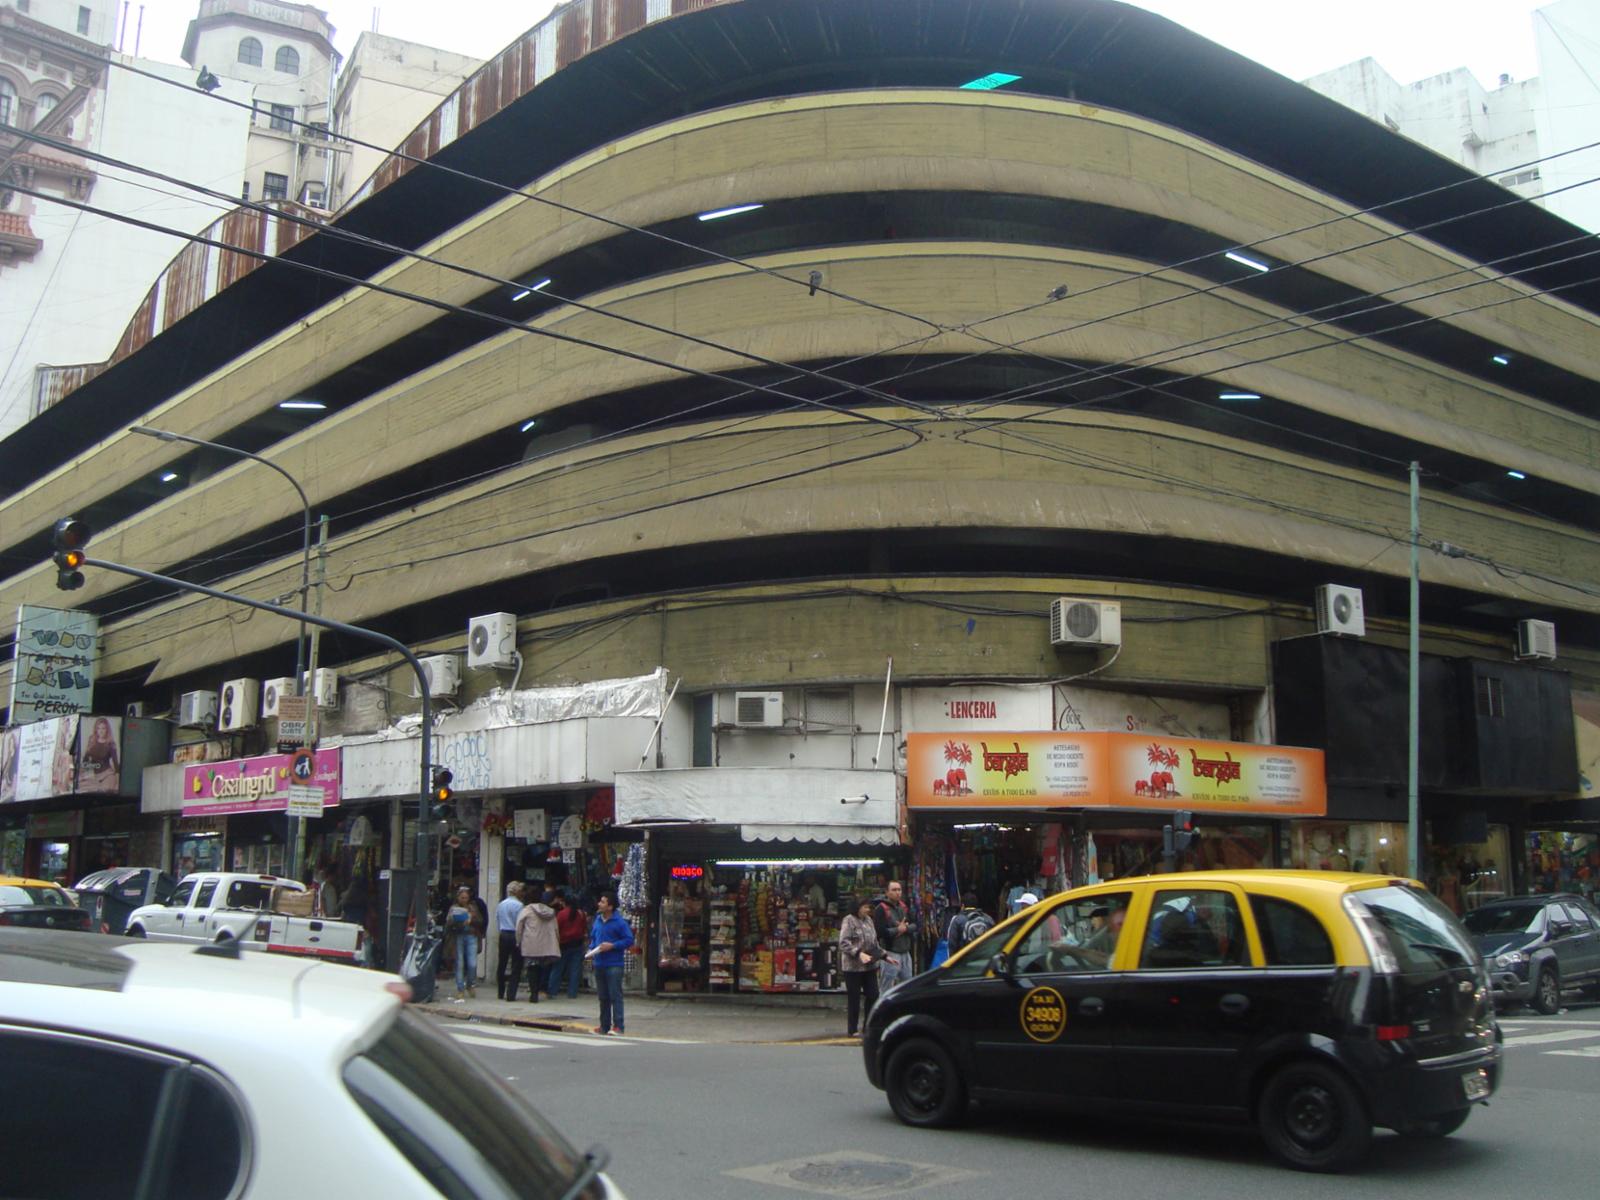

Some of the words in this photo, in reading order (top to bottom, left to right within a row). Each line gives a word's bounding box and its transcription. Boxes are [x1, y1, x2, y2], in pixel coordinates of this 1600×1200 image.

[31, 629, 91, 650] TODO
[34, 699, 79, 714] PERON
[950, 701, 997, 719] LENCERIA
[671, 866, 703, 877] KIOSCO
[1032, 995, 1056, 1003] TAXI
